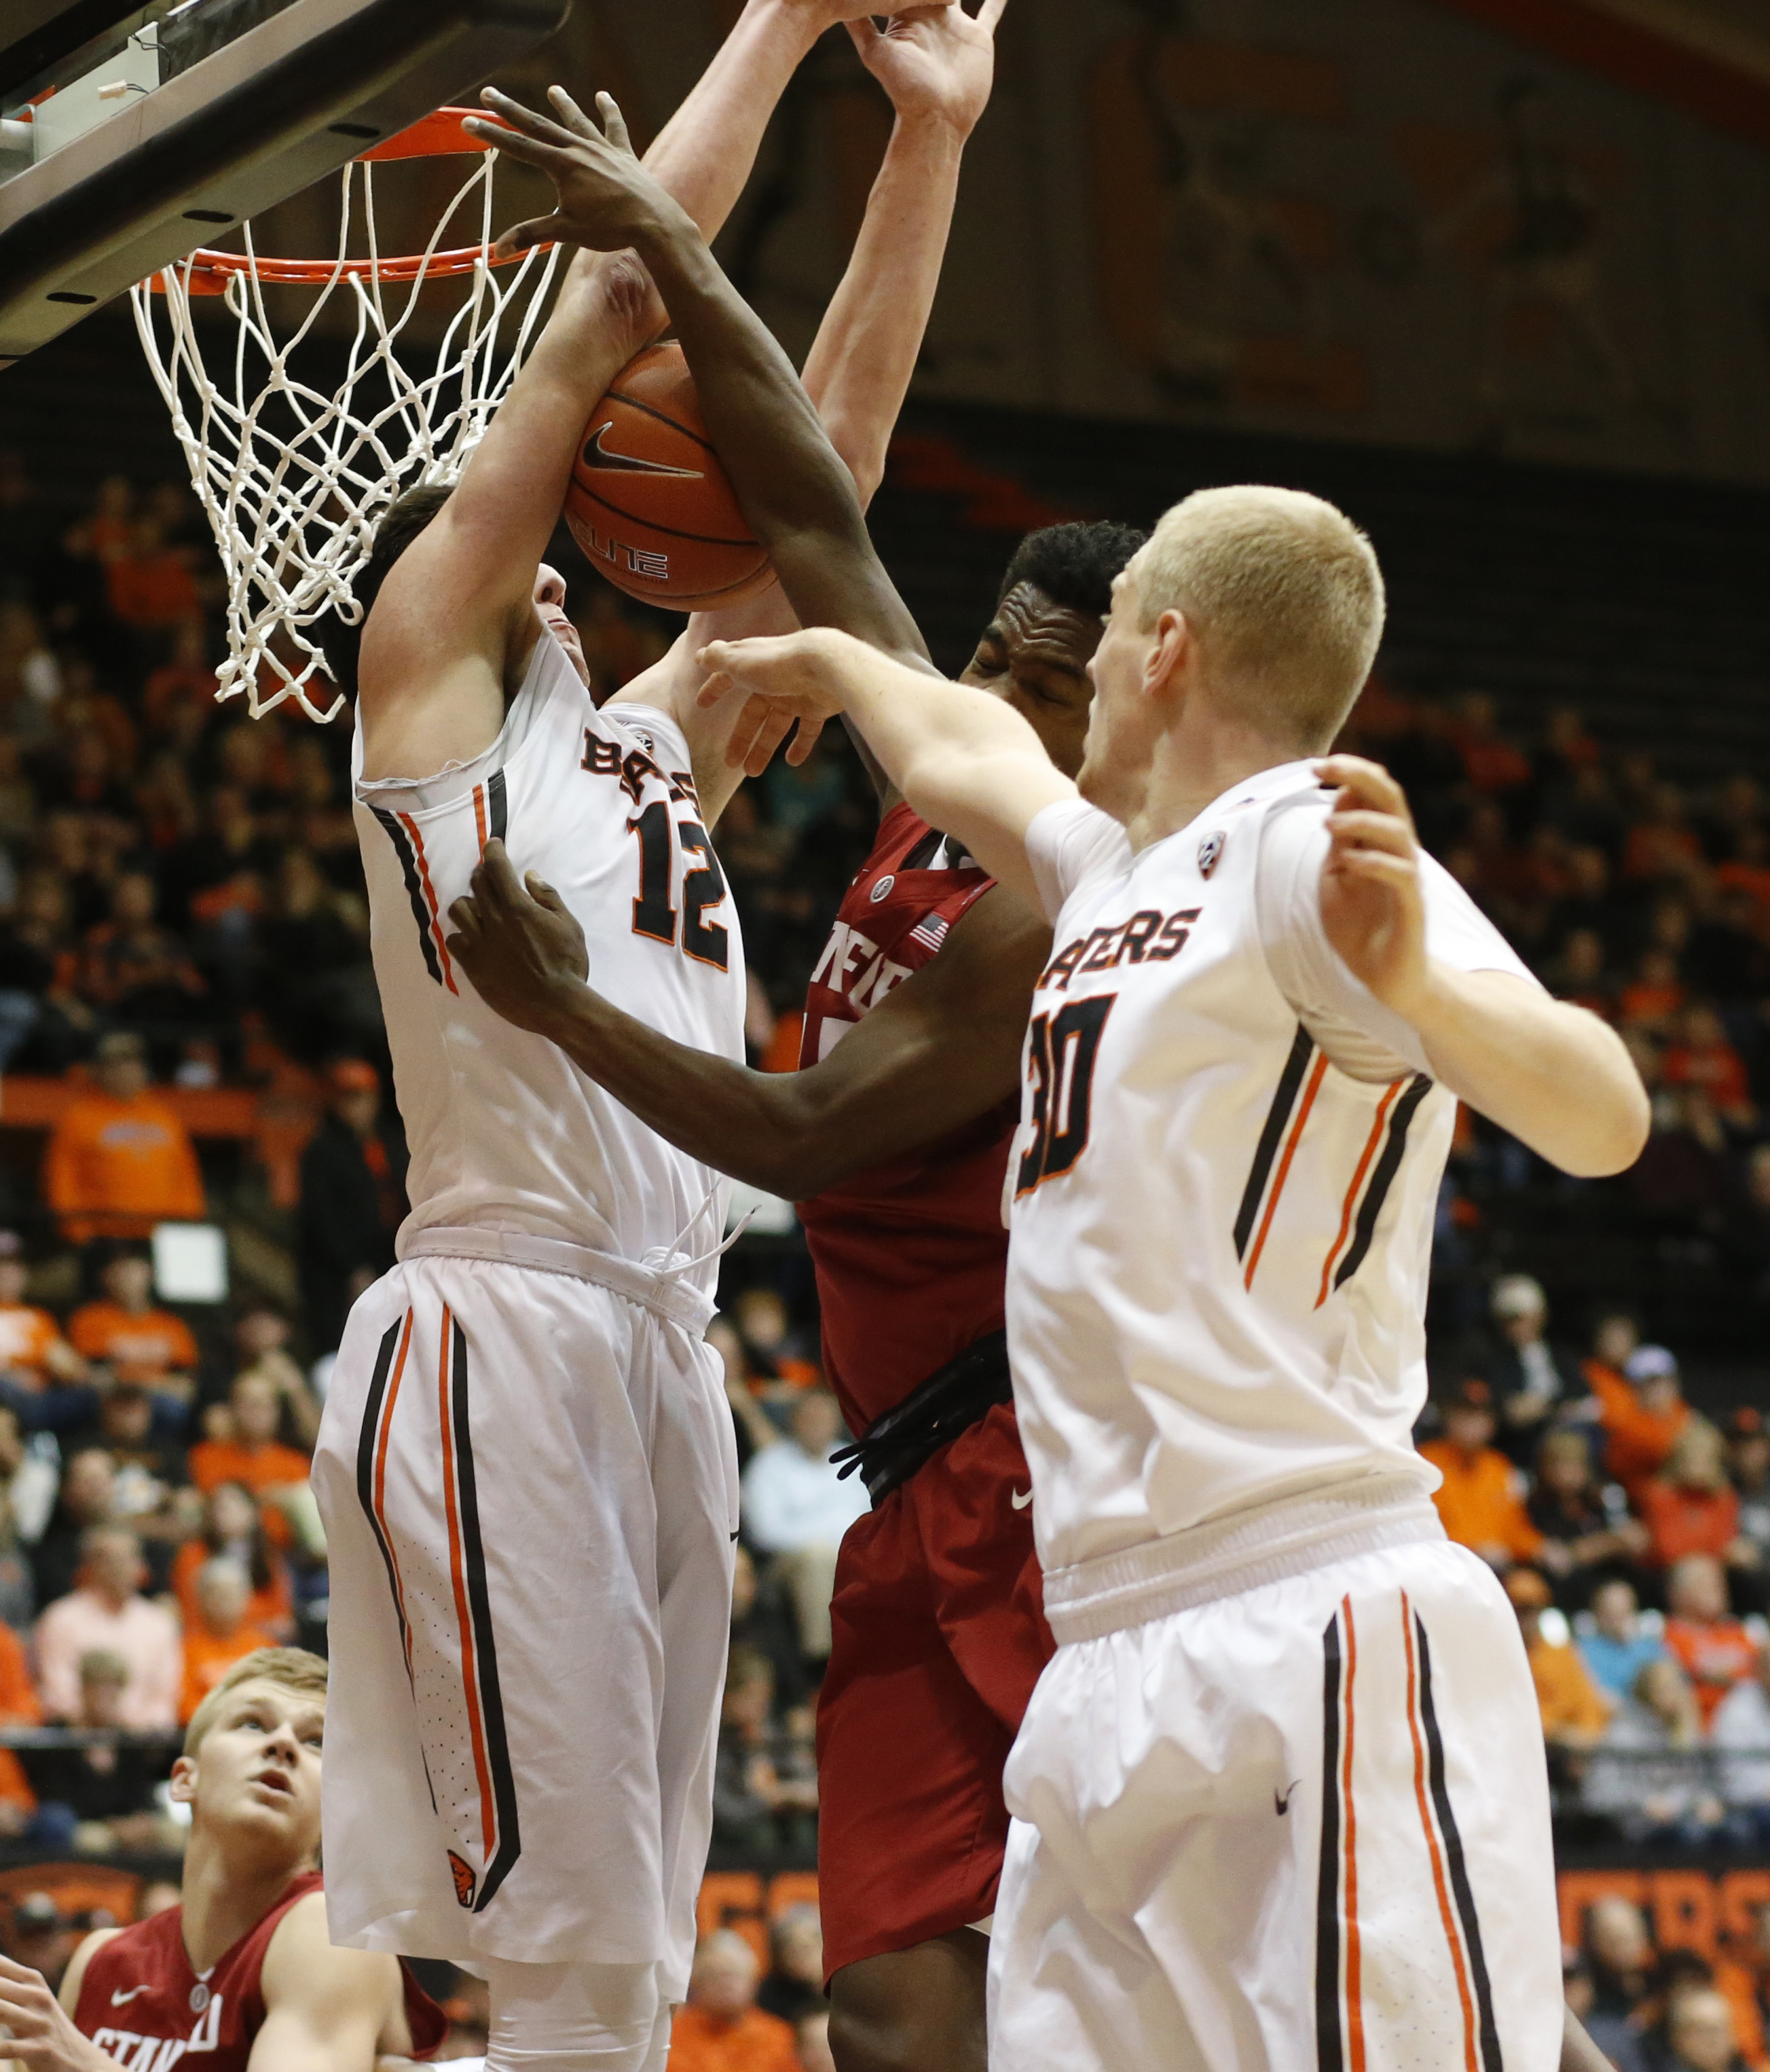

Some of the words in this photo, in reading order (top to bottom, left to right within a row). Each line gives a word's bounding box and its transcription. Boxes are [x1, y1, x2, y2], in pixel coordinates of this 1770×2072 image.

[575, 514, 668, 579] ELITE
[627, 801, 729, 973] 12
[1014, 992, 1118, 1203] 30
